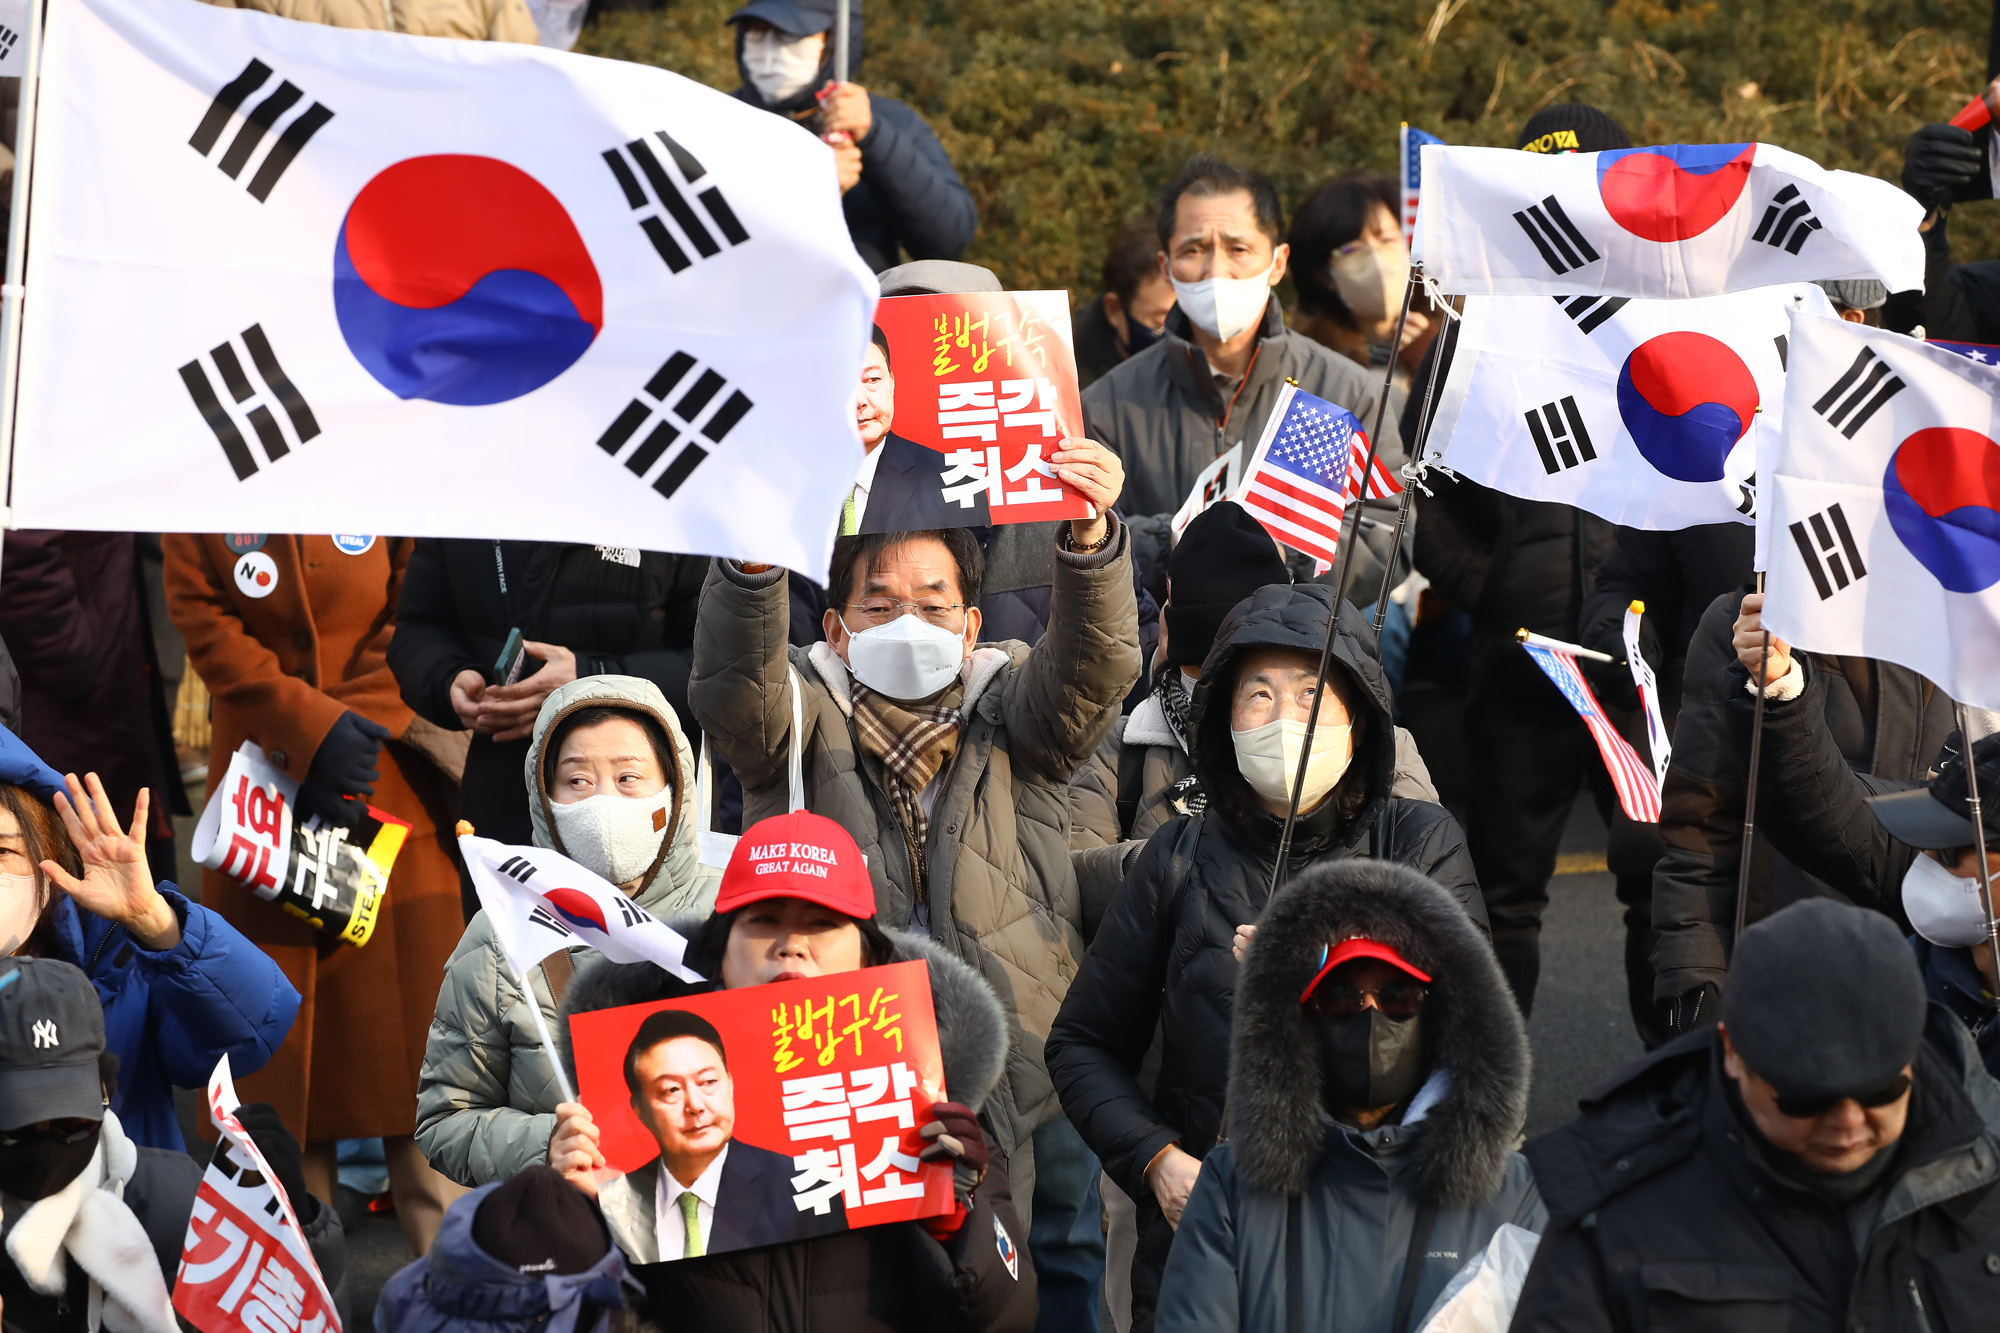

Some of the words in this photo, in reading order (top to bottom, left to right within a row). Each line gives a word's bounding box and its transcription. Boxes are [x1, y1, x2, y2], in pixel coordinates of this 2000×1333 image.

[938, 377, 1057, 442] 즉각
[939, 444, 1063, 508] 취소
[235, 533, 258, 547] OUT
[339, 535, 366, 547] STEAL
[601, 552, 624, 565] FACE
[498, 573, 507, 594] FACE
[748, 843, 787, 861] MAKE
[789, 843, 838, 865] KOREA
[755, 861, 790, 875] GREAT
[791, 861, 828, 879] AGAIN
[32, 1019, 59, 1049] NY
[772, 987, 902, 1073] 불법구속
[782, 1062, 917, 1141] 즉각
[790, 1136, 925, 1216] 취소
